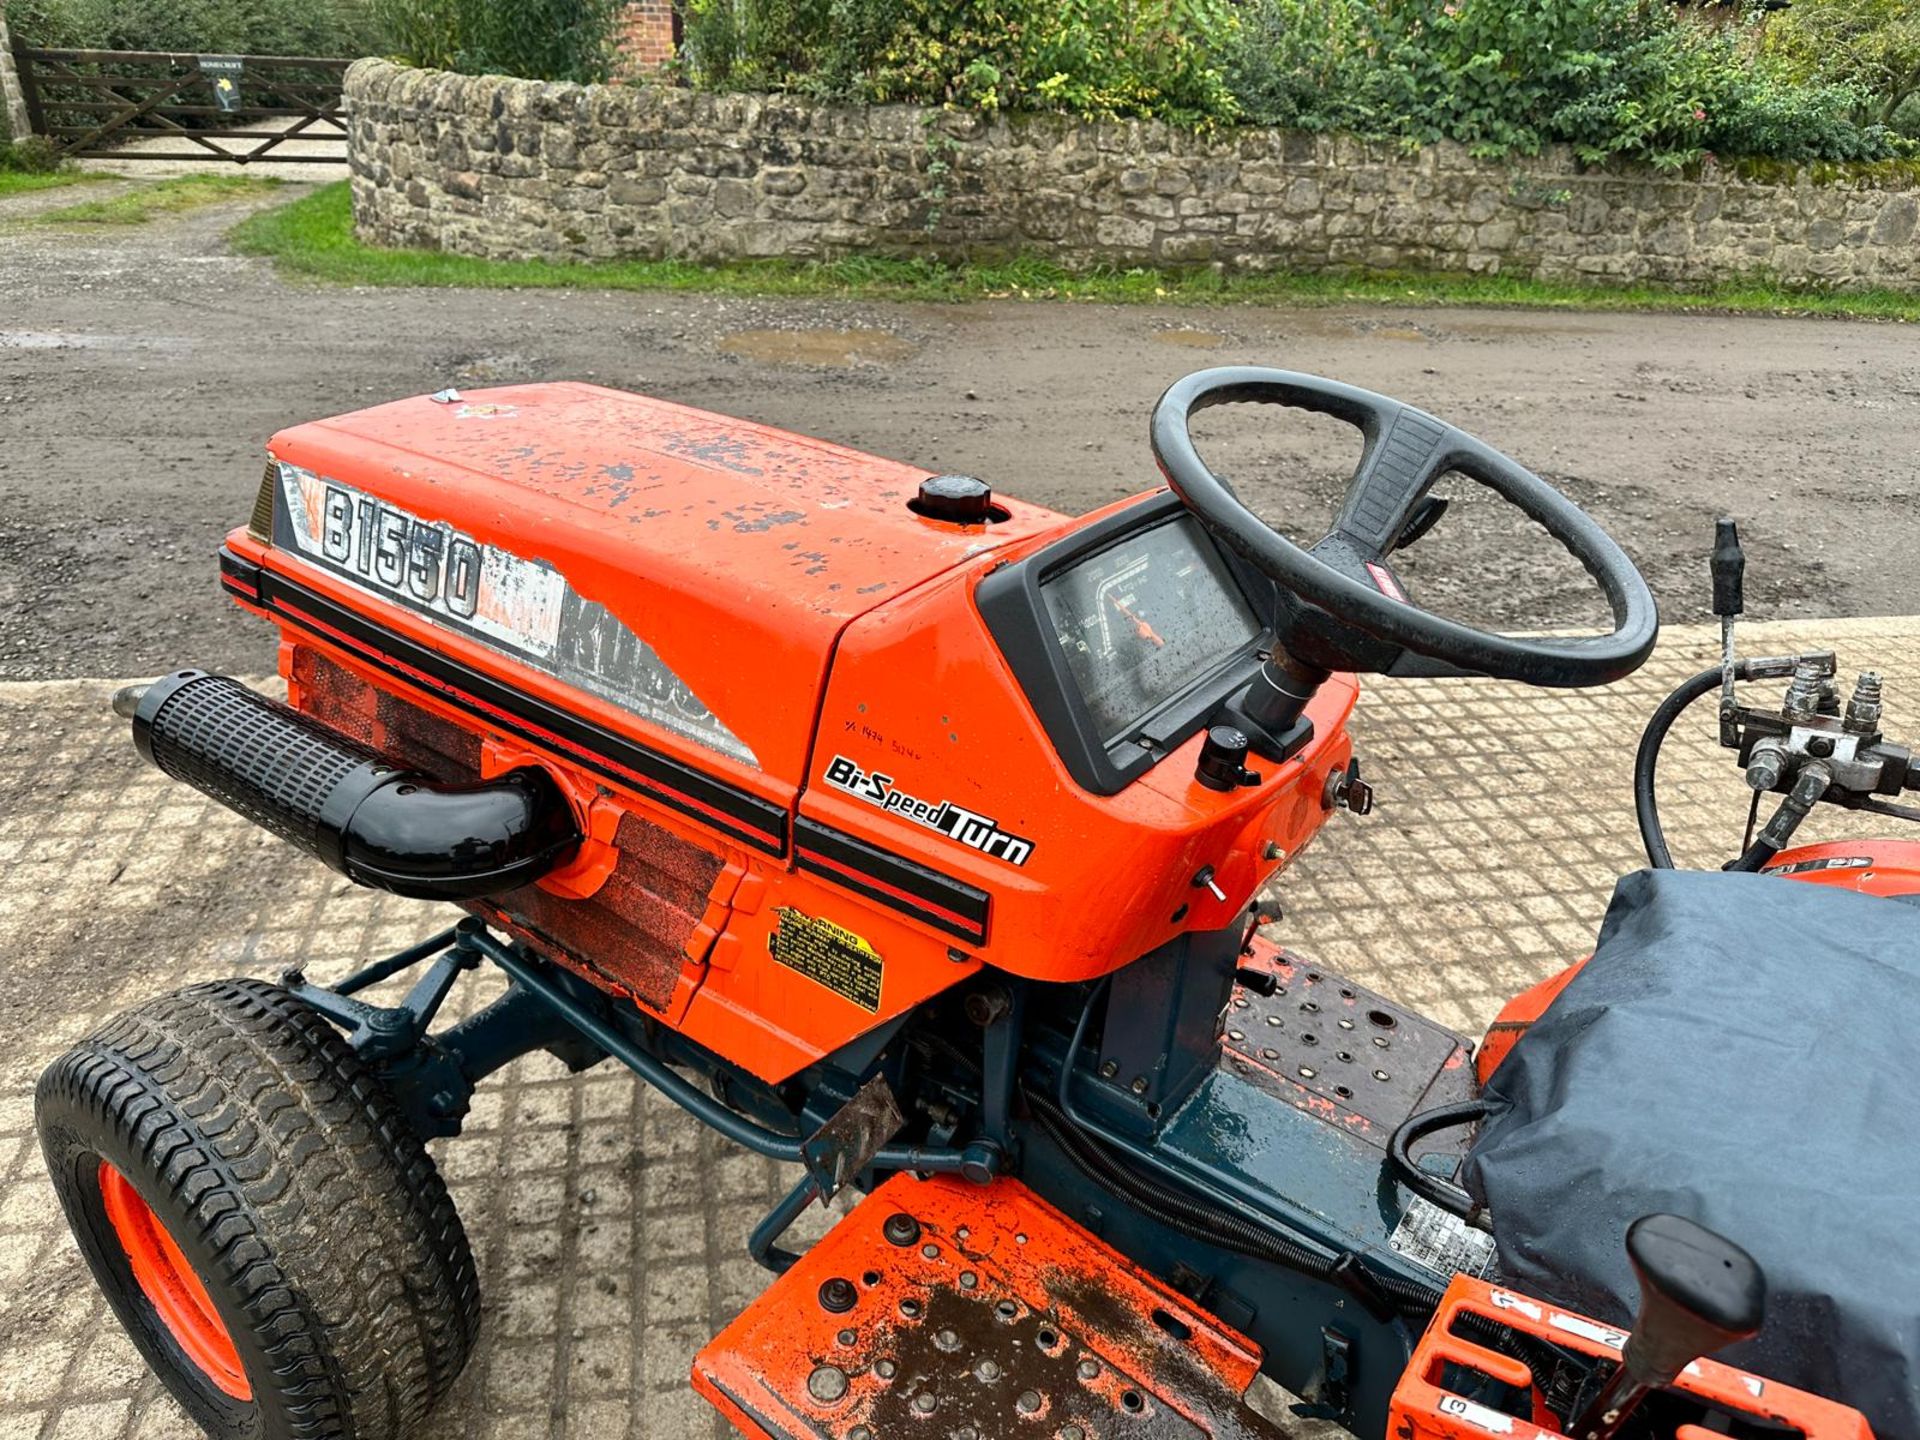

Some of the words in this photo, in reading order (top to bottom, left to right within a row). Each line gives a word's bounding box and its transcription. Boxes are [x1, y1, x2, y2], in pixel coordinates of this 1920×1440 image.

[323, 487, 482, 619] B1550
[825, 756, 947, 826] Bi-Speed
[948, 805, 1032, 865] Turn
[815, 918, 859, 946] RNING
[1450, 1399, 1467, 1414] 3
